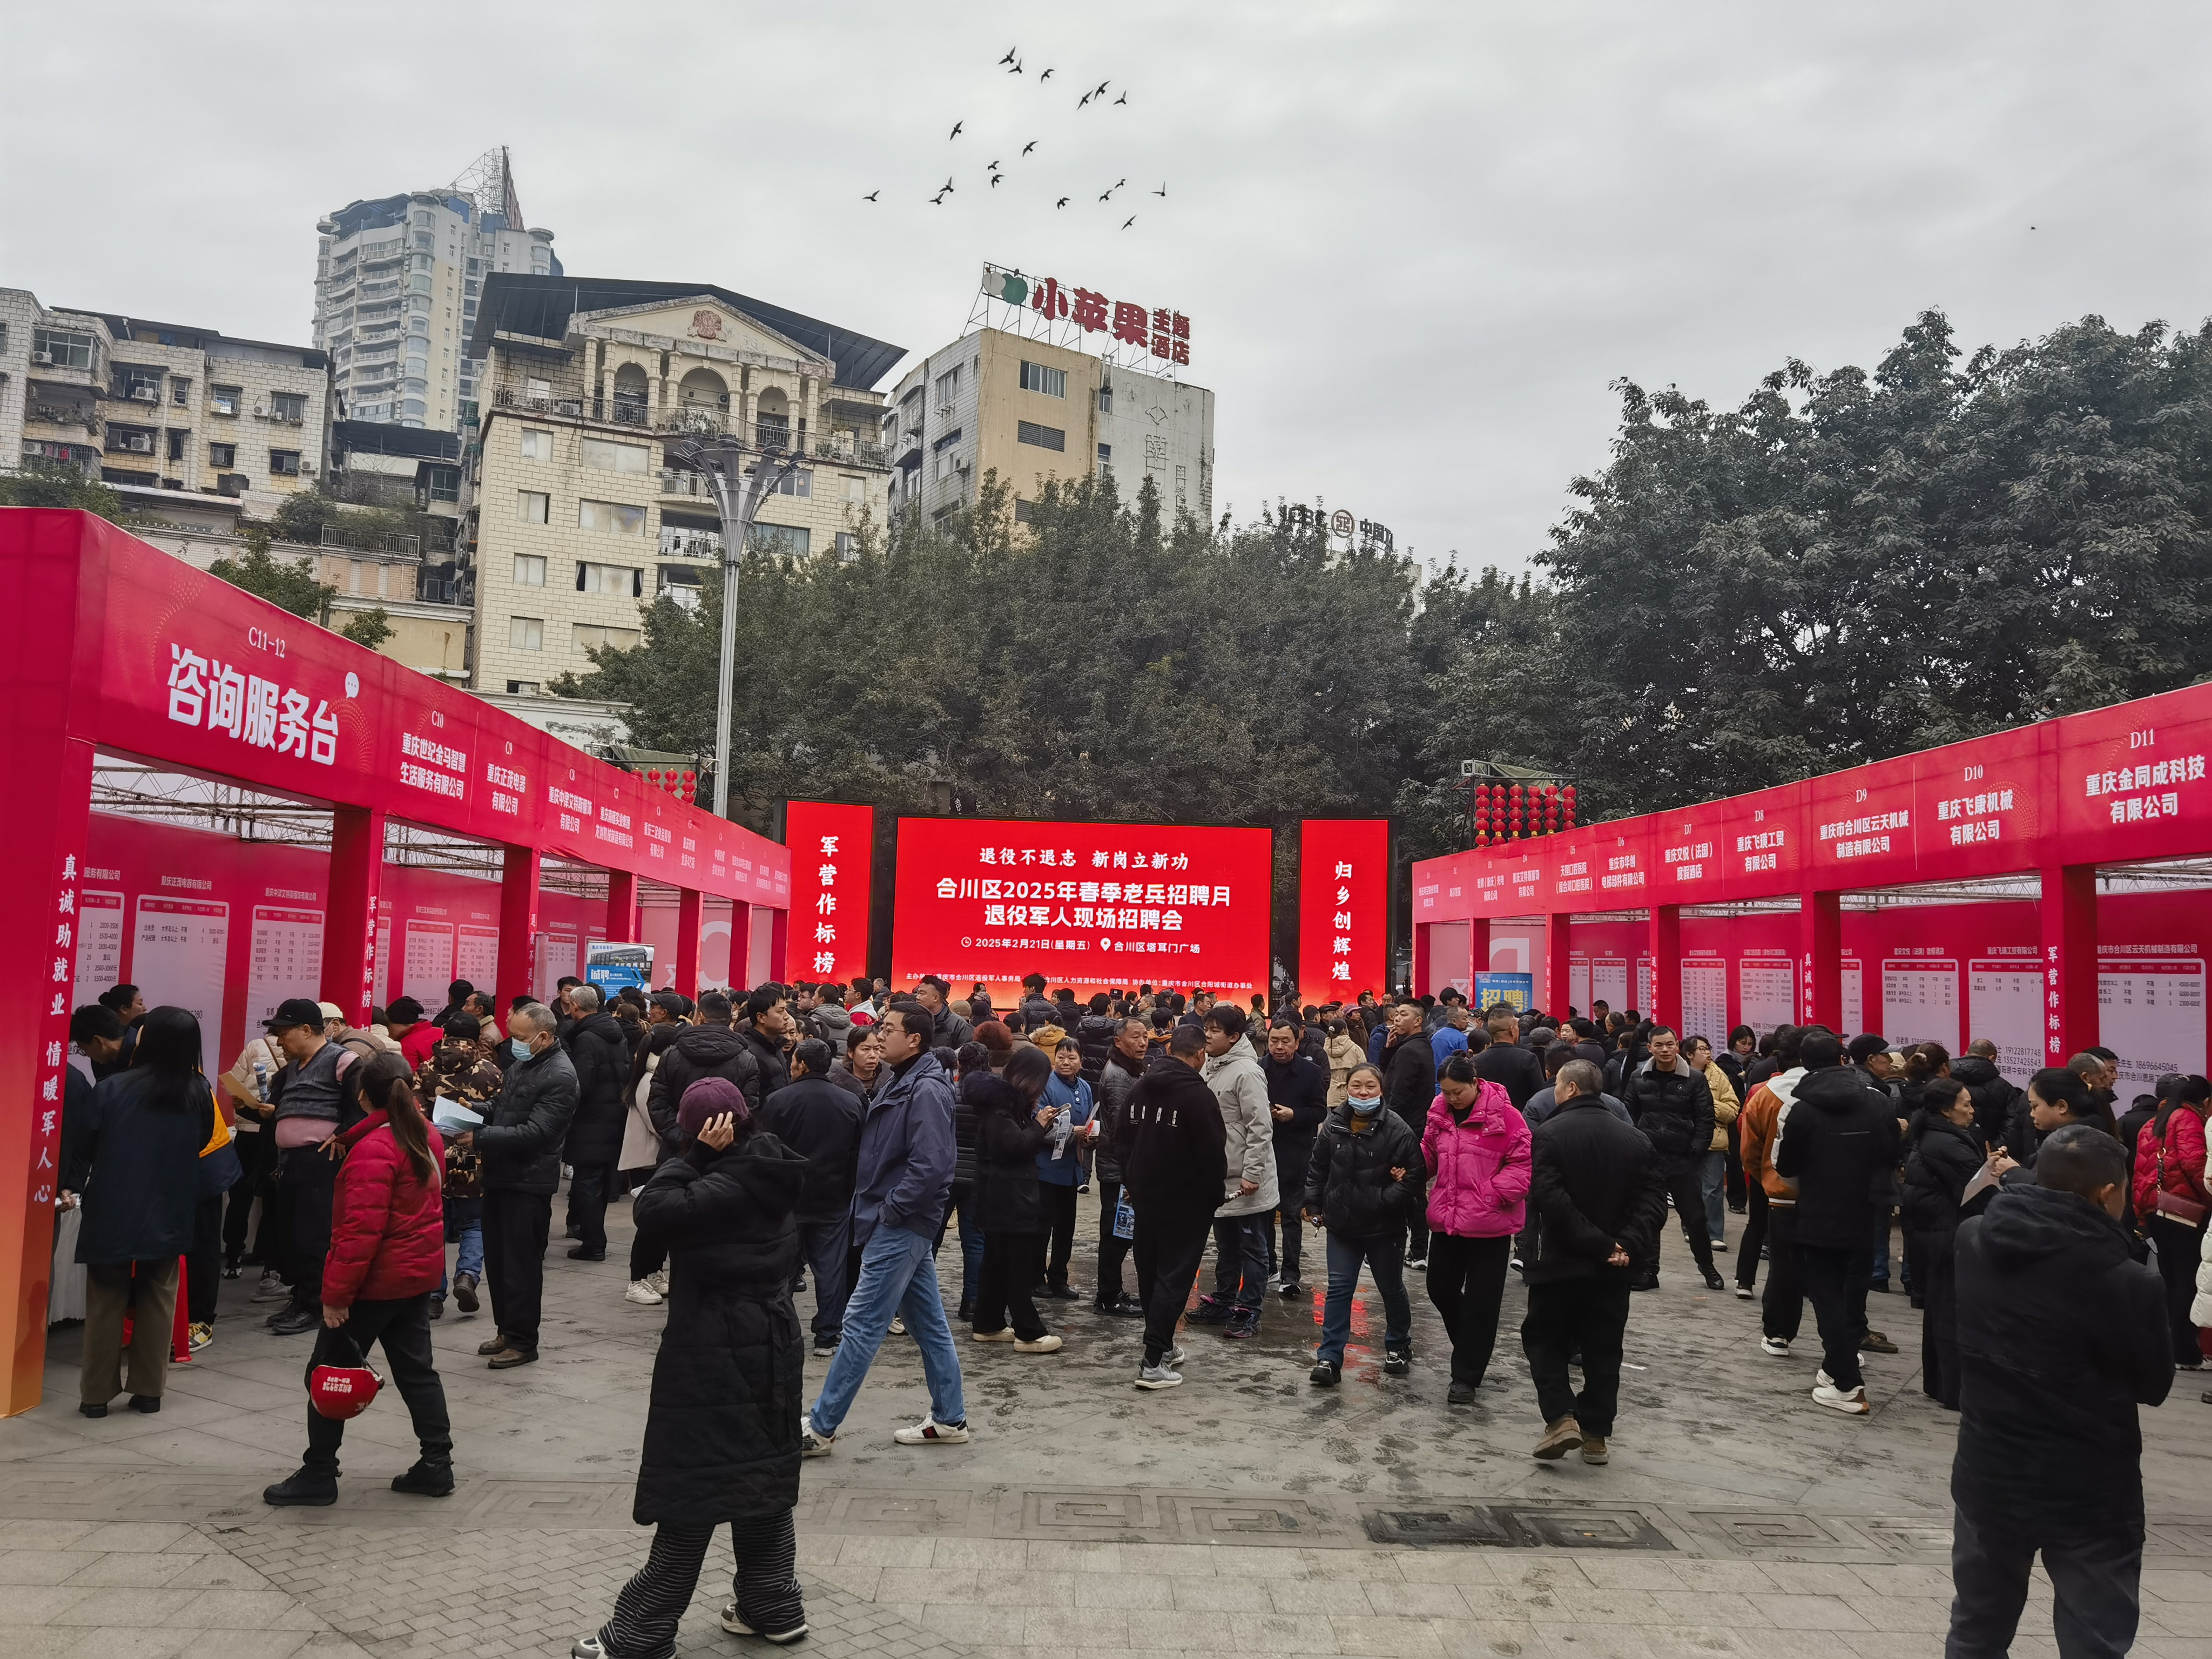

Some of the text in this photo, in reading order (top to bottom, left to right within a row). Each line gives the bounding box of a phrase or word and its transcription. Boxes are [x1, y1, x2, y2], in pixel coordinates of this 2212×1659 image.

[1032, 277, 1148, 348] 小苹果
[1153, 308, 1190, 340] 主题
[1151, 333, 1189, 366] 酒店
[1283, 504, 1327, 526] ICB
[248, 626, 286, 659] C11-12
[167, 643, 339, 766] 咨询服务台
[432, 711, 444, 728] C10
[505, 741, 512, 755] C9
[2130, 729, 2155, 749] D11
[402, 732, 466, 773] 重庆世纪金马智慧
[400, 761, 464, 800] 生活服务有限公司
[487, 763, 526, 793] 重庆正茂电器
[1964, 764, 1984, 781] D10
[2086, 754, 2206, 797] 重庆金同成科技
[492, 791, 518, 815] 有限公司
[1856, 788, 1867, 803] D9
[1937, 789, 2013, 821] 重庆飞康机械
[1755, 810, 1764, 822] D8
[2110, 792, 2178, 824] 有限公司
[560, 813, 580, 834] 有限公司
[1684, 824, 1692, 835] D7
[1819, 810, 1909, 840] 重庆市合川区云天机械
[1950, 819, 2000, 846] 有限公司
[1618, 837, 1624, 846] D6
[1836, 835, 1890, 859] 制造有限公司
[980, 847, 1189, 871] 退役不退志 新岗立新功
[1745, 853, 1776, 872] 有限公司
[1602, 872, 1644, 889] 电梯部件有限公司
[1677, 864, 1702, 881] 度假酒店
[936, 877, 1230, 907] 合川区2025年春季老兵招聘月
[1518, 886, 1534, 898] 有限公司
[812, 836, 839, 974] 军营作标榜
[984, 904, 1183, 930] 退役军人现场招聘会
[1332, 861, 1352, 980] 归乡创辉煌
[362, 896, 377, 1008] 军营作标榜
[975, 938, 1201, 954] 2025年2月21日(星期五) 合川区塔耳门广场
[591, 969, 610, 983] 诚聘
[1481, 988, 1523, 1013] 招聘
[1804, 953, 1813, 1024] 真诚助就
[2048, 946, 2060, 1054] 军营作标榜
[33, 853, 77, 1203] 真诚助就业 情暖军人心
[2004, 1056, 2041, 1067] 13527425543
[2006, 1047, 2041, 1057] 19122817748
[2135, 1061, 2178, 1073] 18696645045
